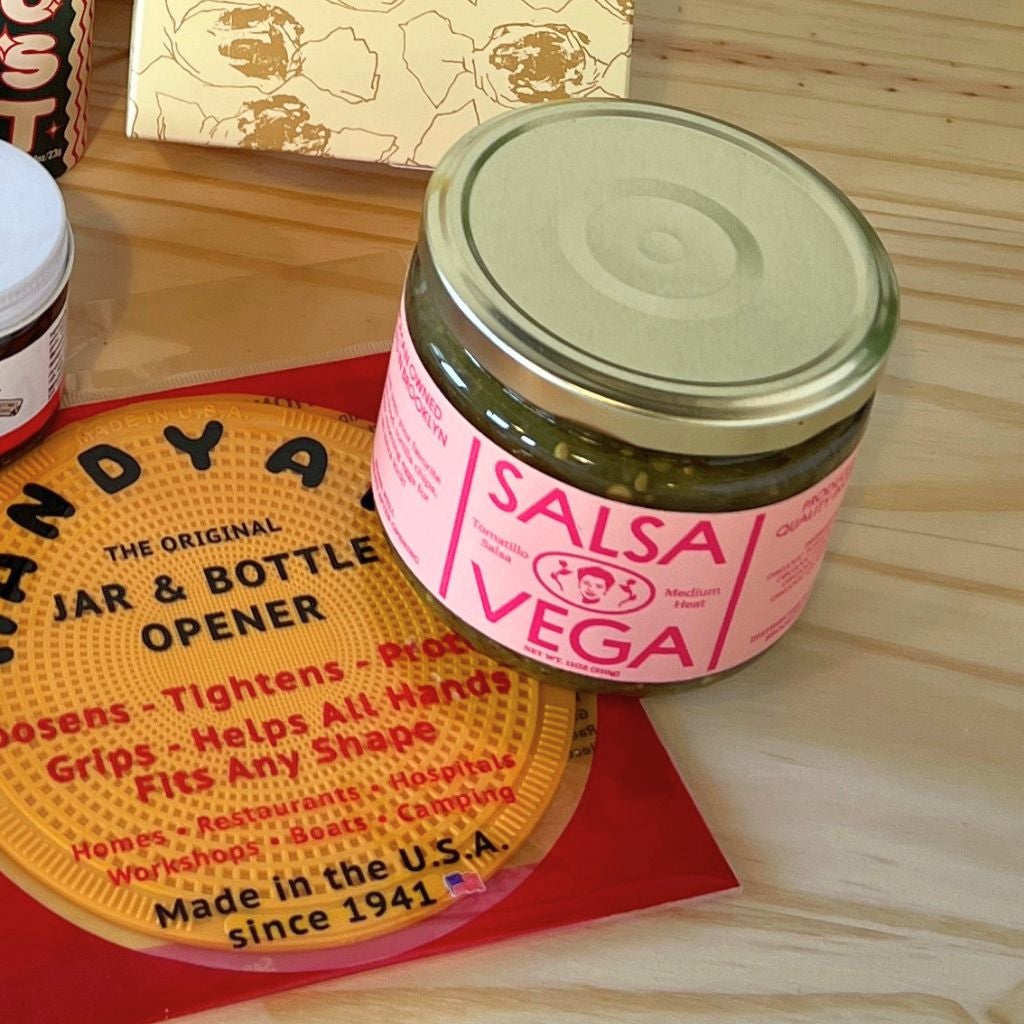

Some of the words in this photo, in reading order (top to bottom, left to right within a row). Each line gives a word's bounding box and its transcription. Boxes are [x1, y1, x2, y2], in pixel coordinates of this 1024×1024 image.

[77, 416, 140, 445] MADE
[145, 409, 169, 423] IN
[103, 539, 154, 562] THE
[161, 517, 282, 554] ORIGINAL
[472, 517, 529, 559] Tomatillo
[480, 538, 512, 564] Salsa
[488, 460, 726, 565] SALSA
[52, 583, 134, 622] JAR
[154, 574, 187, 604] &
[203, 535, 380, 595] BOTTLE
[471, 559, 694, 668] VEGA
[665, 587, 721, 598] Medium
[675, 599, 705, 609] Heat
[141, 594, 327, 653] OPENER
[162, 660, 344, 713] Tightens
[378, 632, 476, 668] Prot
[46, 743, 156, 784] Grips
[191, 710, 308, 754] Helps
[321, 692, 377, 729] All
[385, 668, 511, 711] Hands
[134, 766, 215, 805] Fits
[228, 749, 299, 784] Any
[311, 718, 439, 765] Shape
[71, 830, 166, 862] Homes
[196, 785, 361, 835] Restaurants
[389, 752, 516, 791] Hospitals
[107, 839, 260, 887] Workshops
[290, 815, 367, 847] Boats
[396, 784, 516, 823] Camping
[154, 887, 261, 929] Made
[276, 875, 312, 902] in
[326, 857, 389, 892] the
[399, 829, 509, 873] U.S.A.
[228, 909, 330, 950] since
[342, 881, 438, 925] 1941
